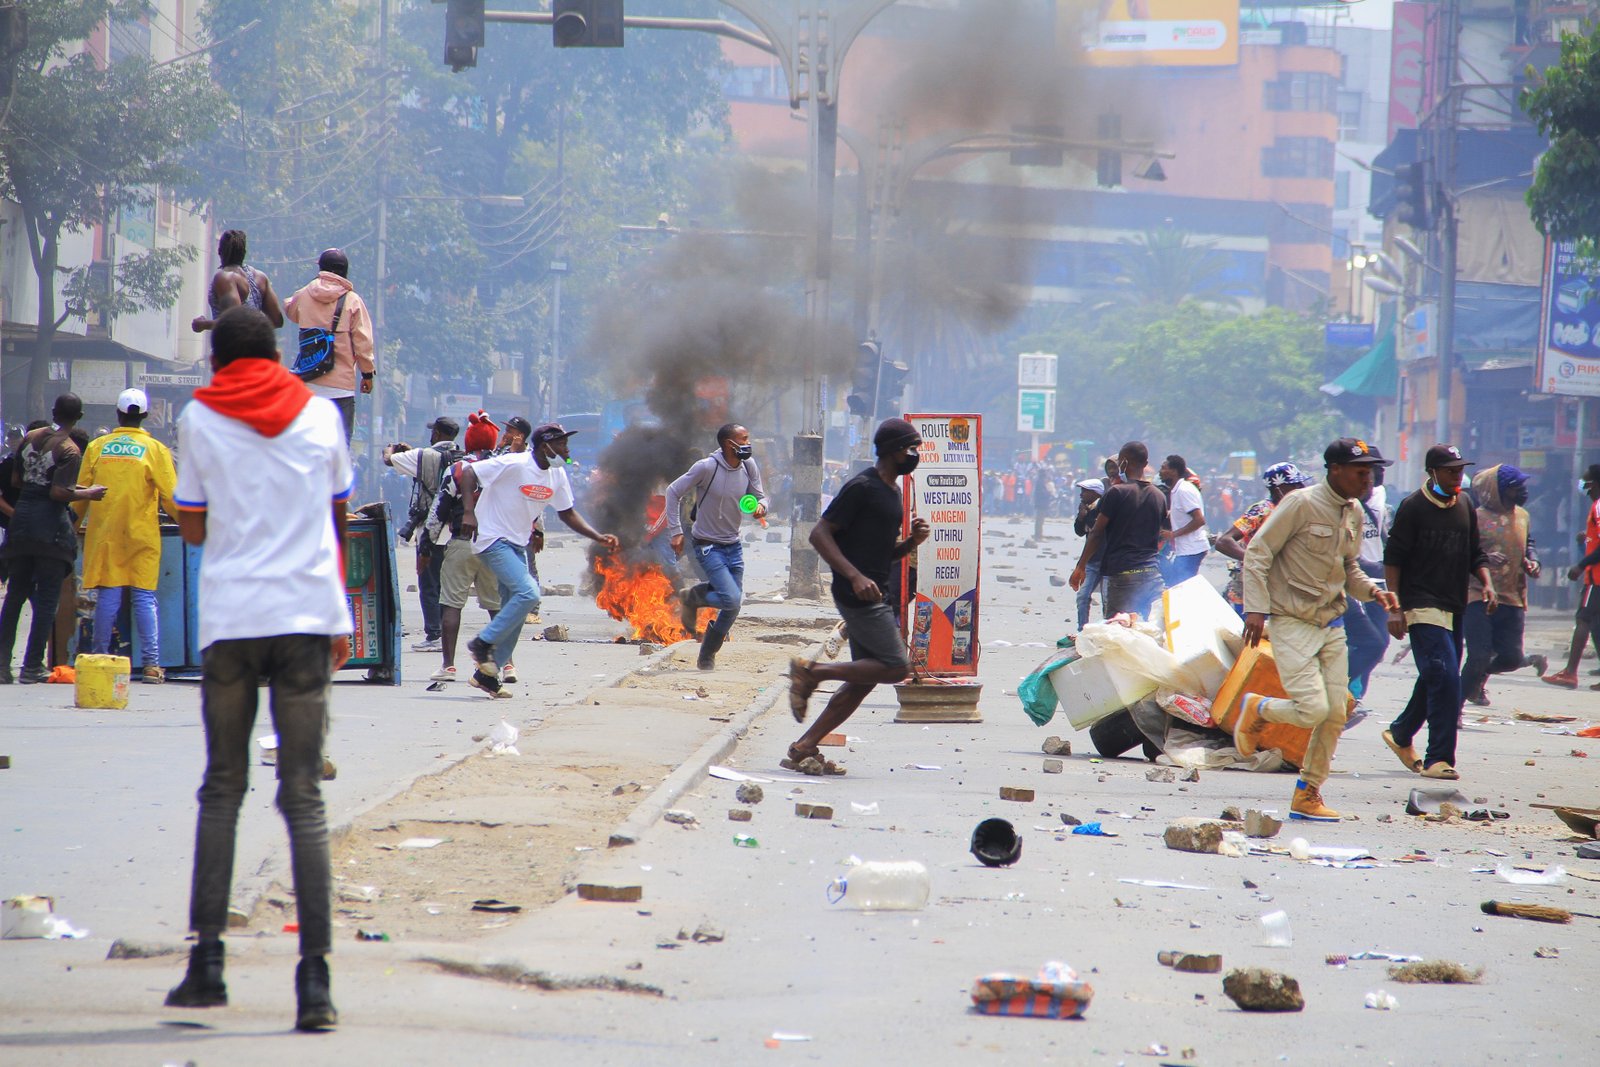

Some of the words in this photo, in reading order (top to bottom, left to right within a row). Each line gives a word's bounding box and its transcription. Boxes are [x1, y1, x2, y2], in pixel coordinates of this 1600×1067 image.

[1560, 240, 1577, 253] YOU
[177, 377, 201, 385] STREET
[921, 424, 949, 438] ROUTE
[103, 443, 142, 456] SOKO
[919, 453, 940, 463] ACCO
[923, 491, 972, 505] WESTLANDS
[930, 510, 967, 523] KANGEMI
[934, 529, 963, 542] UTHIRU
[936, 547, 960, 560] KINOO
[935, 566, 960, 579] REGEN
[932, 585, 960, 598] KIKUYU
